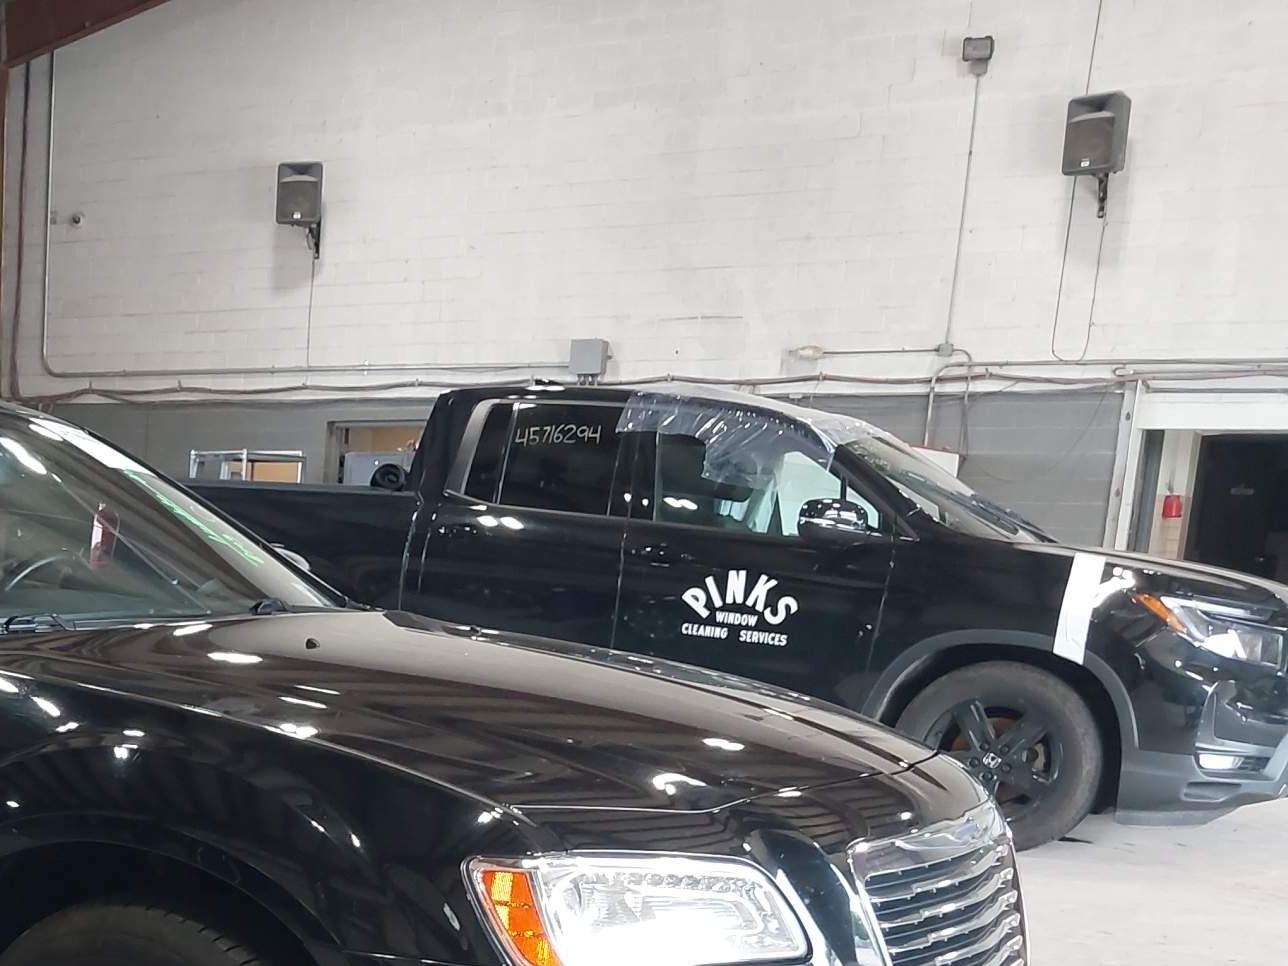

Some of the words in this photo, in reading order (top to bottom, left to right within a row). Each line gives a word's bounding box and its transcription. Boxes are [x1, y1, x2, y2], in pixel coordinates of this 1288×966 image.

[515, 424, 602, 448] 45716294
[681, 570, 799, 625] PINKS
[715, 610, 758, 627] WINDOW
[681, 622, 729, 640] CLEANING
[739, 629, 788, 647] SERVICES
